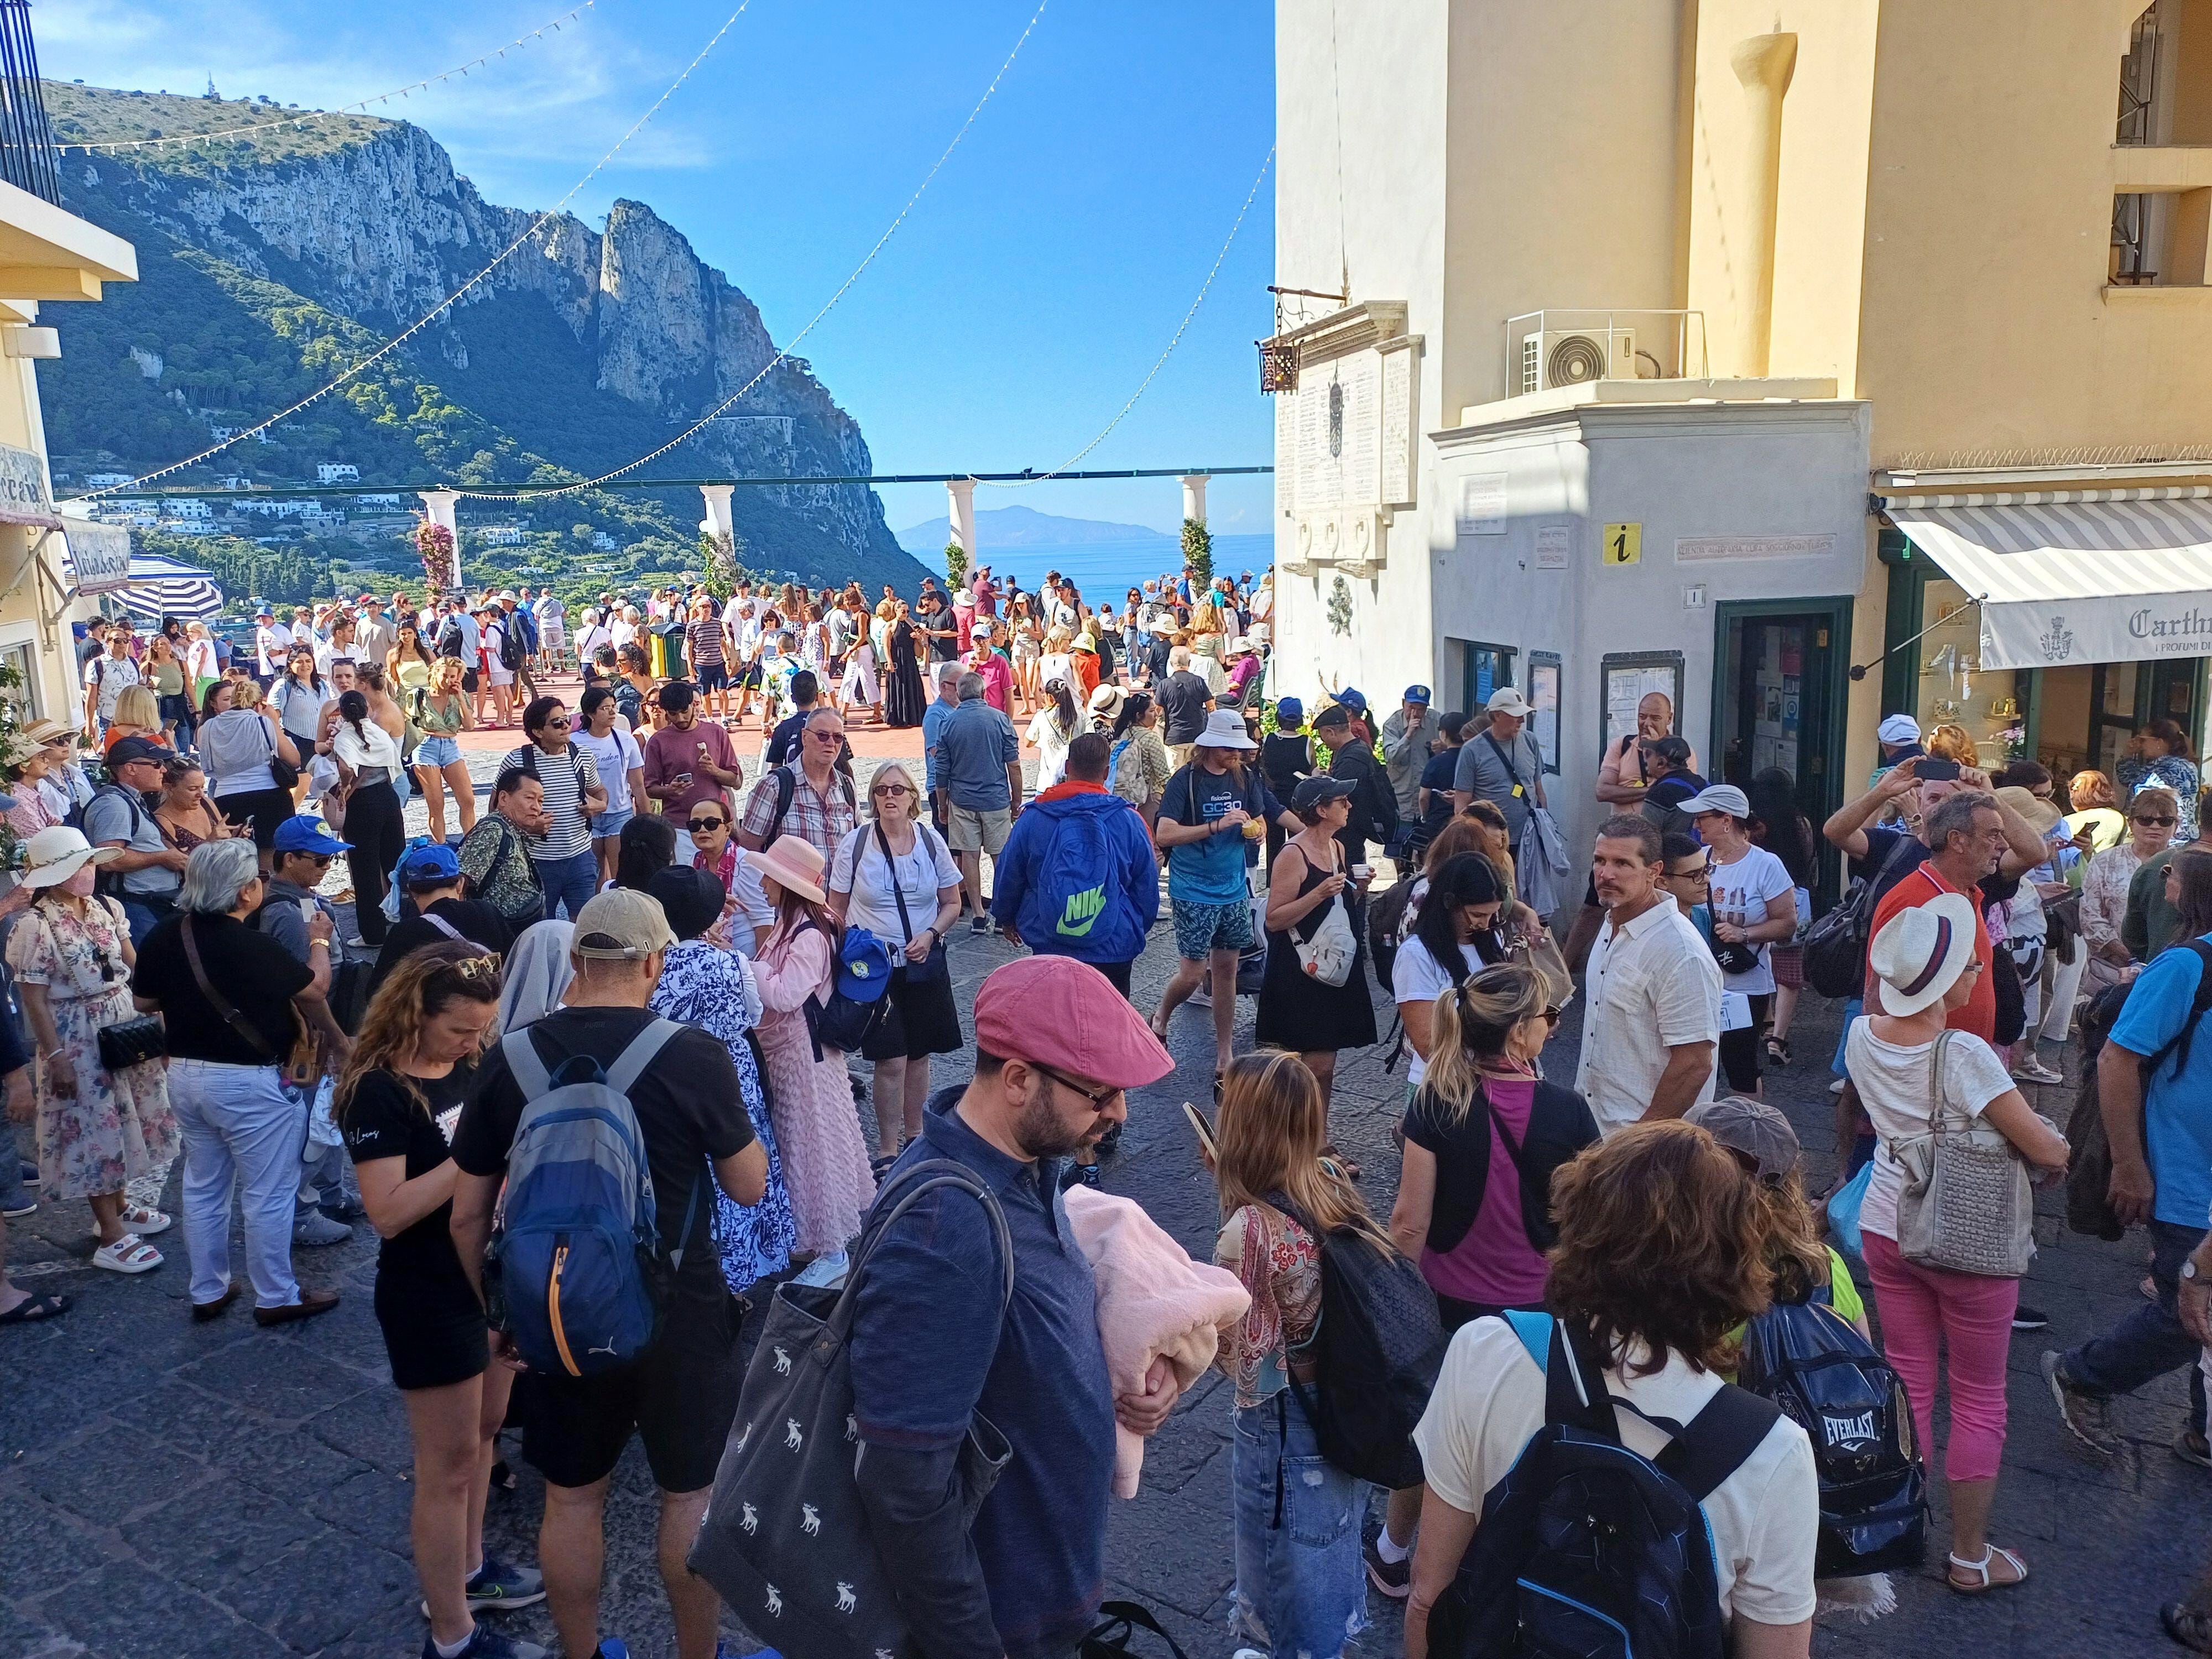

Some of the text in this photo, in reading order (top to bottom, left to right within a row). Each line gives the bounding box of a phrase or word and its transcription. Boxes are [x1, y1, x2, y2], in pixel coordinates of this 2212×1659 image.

[1613, 525, 1630, 562] i
[2161, 642, 2199, 651] PROFUMI
[2201, 641, 2210, 650] DI
[1203, 800, 1242, 813] GC30
[1065, 883, 1105, 922] NIK
[1822, 1410, 1876, 1446] EVERLAST
